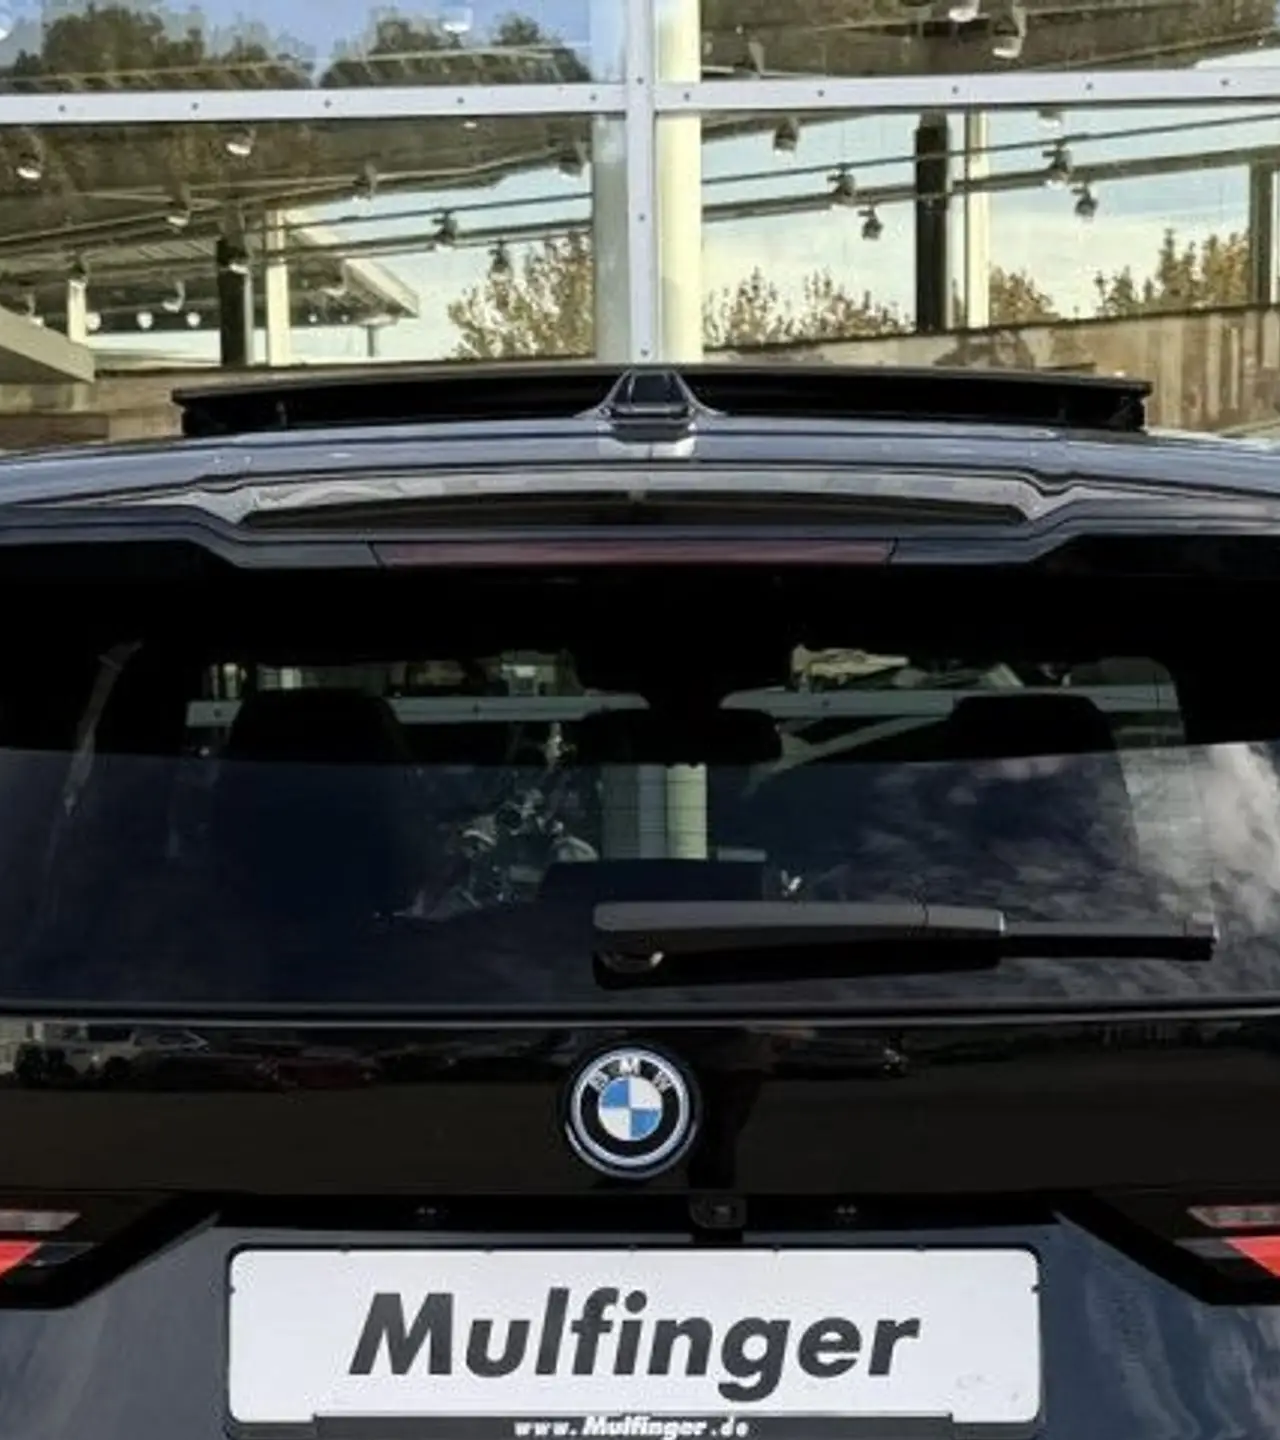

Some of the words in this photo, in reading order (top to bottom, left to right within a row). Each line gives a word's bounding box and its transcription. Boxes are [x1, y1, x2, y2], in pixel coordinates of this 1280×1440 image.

[587, 1055, 673, 1093] BMW
[348, 1286, 921, 1403] Mulfinger
[514, 1414, 749, 1440] www.Mulfinger.de
